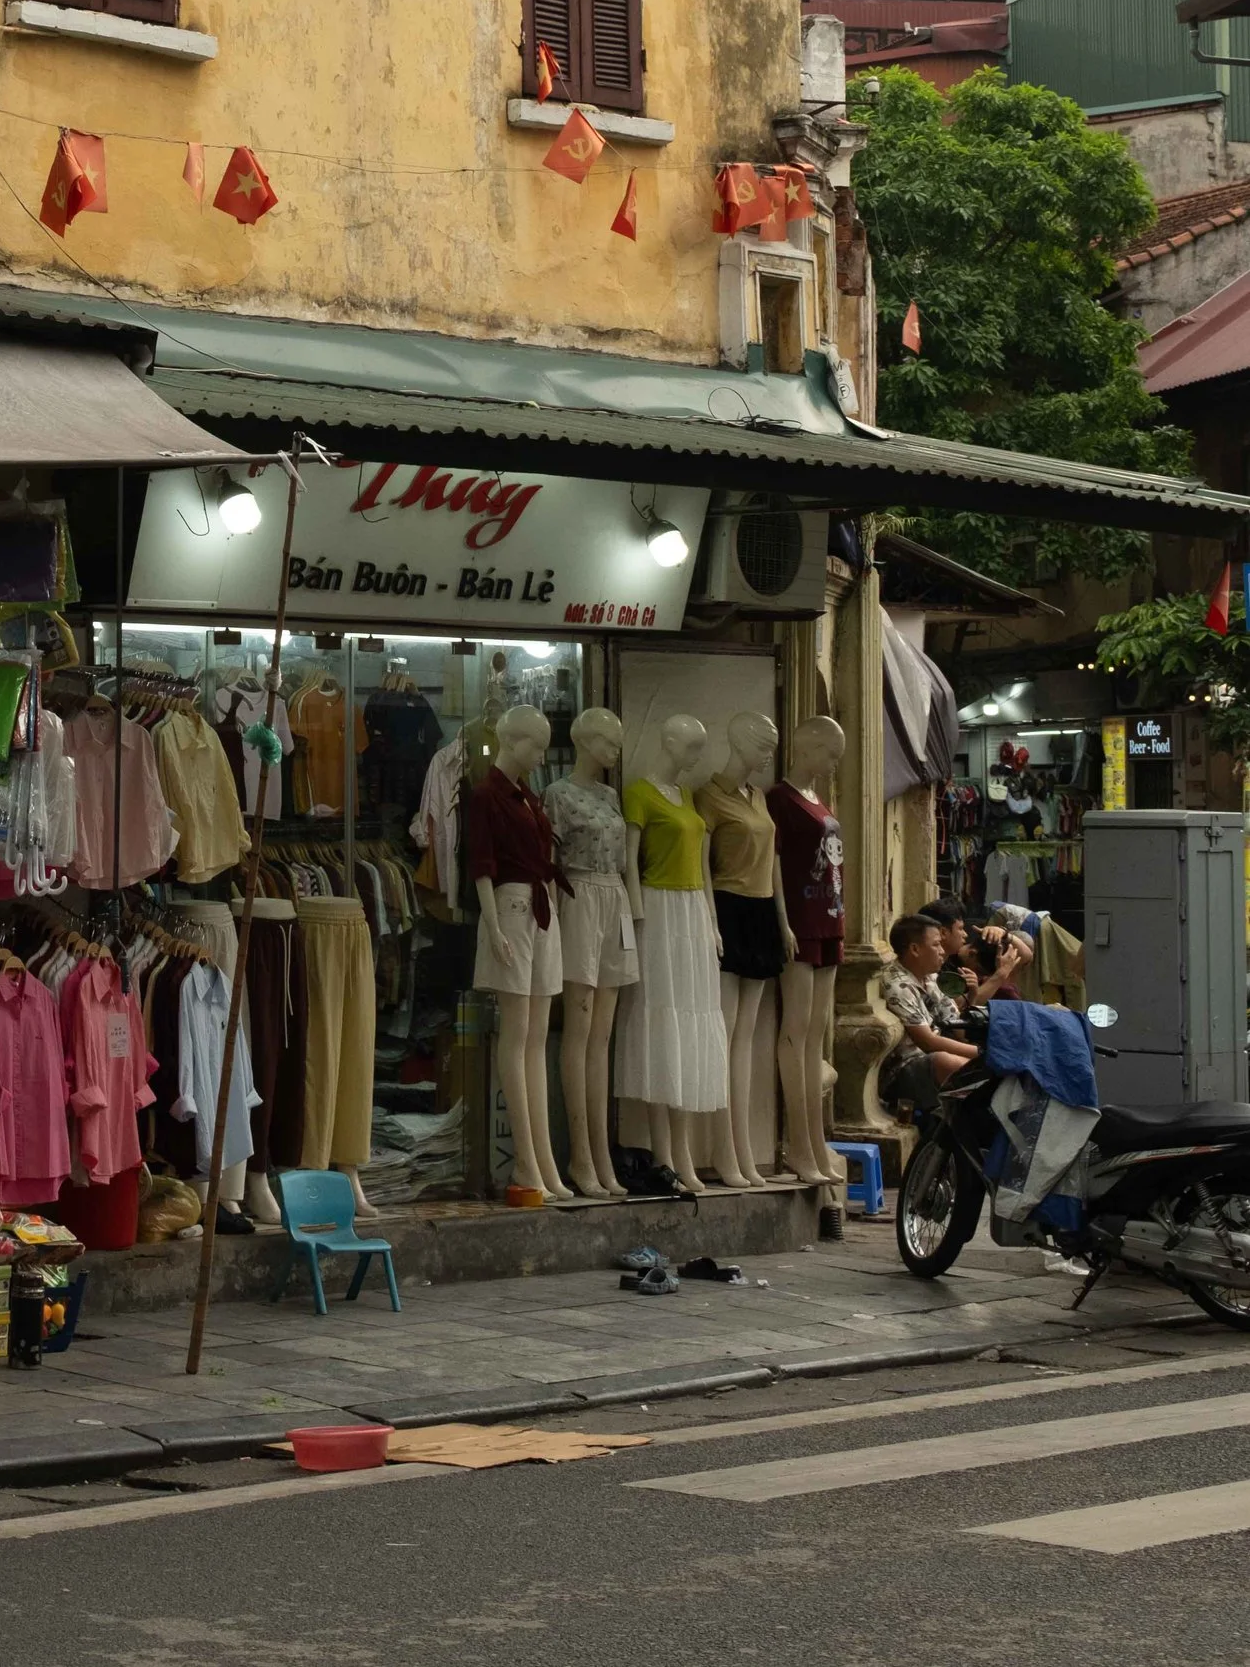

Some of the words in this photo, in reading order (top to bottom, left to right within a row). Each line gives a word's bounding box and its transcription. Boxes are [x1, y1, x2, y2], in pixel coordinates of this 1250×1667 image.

[287, 556, 344, 591] Bán
[352, 560, 428, 596] Buôn
[457, 566, 514, 600] Bán
[522, 569, 556, 603] Lẻ
[563, 602, 589, 624] Add:
[590, 599, 609, 624] Số
[606, 603, 616, 622] 8
[641, 604, 657, 627] Cá
[1137, 720, 1162, 736] Coffee
[1129, 739, 1147, 754] Beer
[1151, 737, 1171, 754] Food
